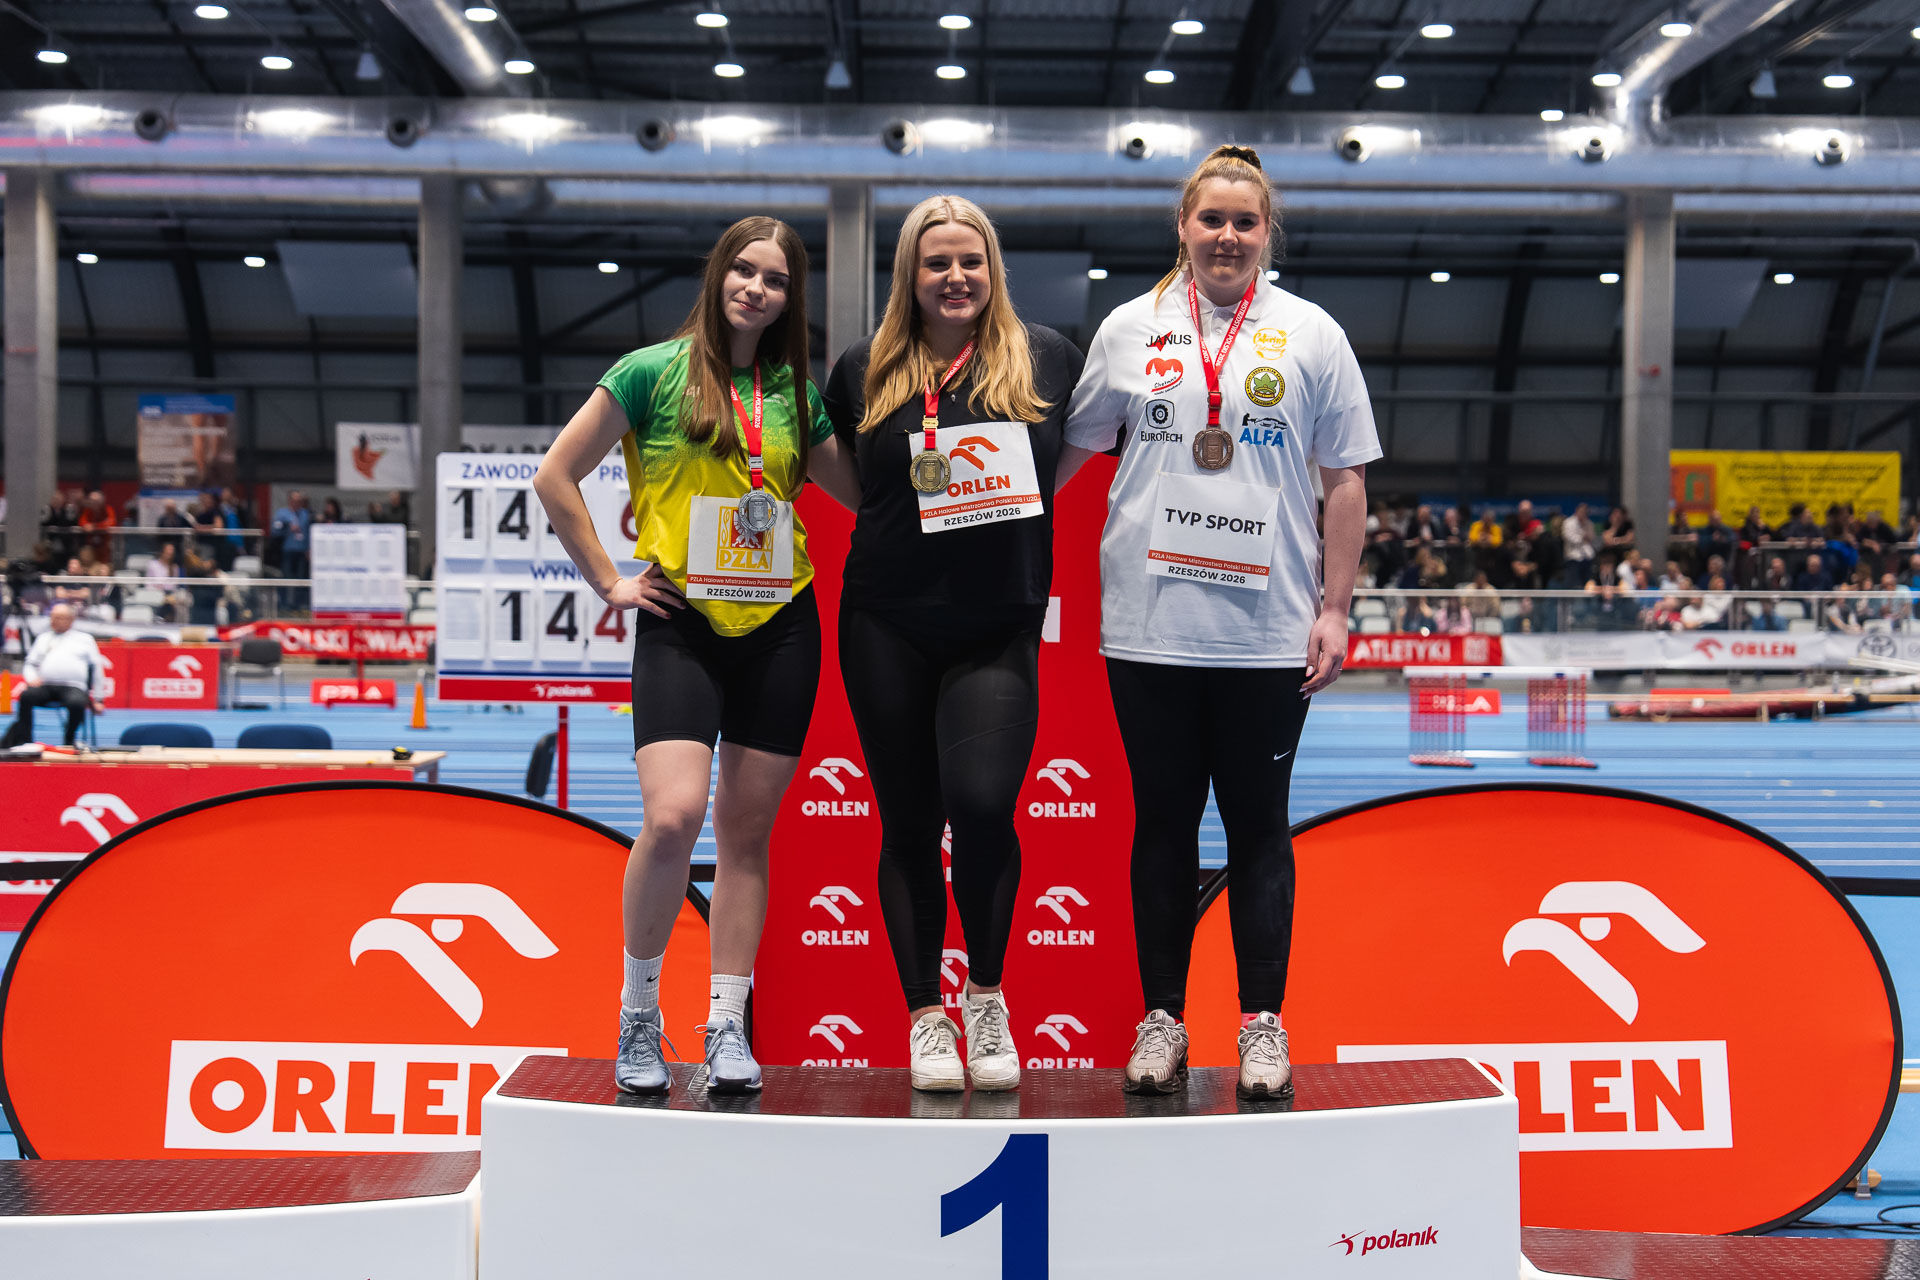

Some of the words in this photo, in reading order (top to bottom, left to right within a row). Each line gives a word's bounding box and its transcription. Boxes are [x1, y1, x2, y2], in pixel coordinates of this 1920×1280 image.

[1146, 334, 1192, 348] JANUS
[1221, 334, 1234, 354] POLSKI
[1239, 428, 1284, 448] ALFA
[947, 475, 1011, 497] ORLEN
[939, 507, 960, 515] Halowe
[961, 501, 994, 511] Mistrzostwa
[944, 511, 993, 526] RZESZÓW
[996, 507, 1021, 518] 2026
[1165, 508, 1202, 526] TVP
[1206, 514, 1266, 536] SPORT
[720, 549, 769, 569] PZLA
[1166, 554, 1188, 563] Halowe
[1189, 557, 1222, 568] Mistrzostwa
[1168, 565, 1218, 580] RZESZÓW
[1221, 573, 1246, 584] 2026
[707, 588, 753, 598] RZESZÓW
[1353, 639, 1451, 662] ATLETYKI
[1731, 642, 1797, 657] ORLEN
[802, 800, 869, 817] ORLEN
[1028, 802, 1095, 818] ORLEN
[802, 930, 869, 946] ORLEN
[1027, 930, 1094, 946] ORLEN
[1027, 1058, 1094, 1069] ORLEN
[1513, 1058, 1705, 1134] LEN
[941, 1134, 1048, 1280] 1
[1361, 1226, 1439, 1256] polanik
